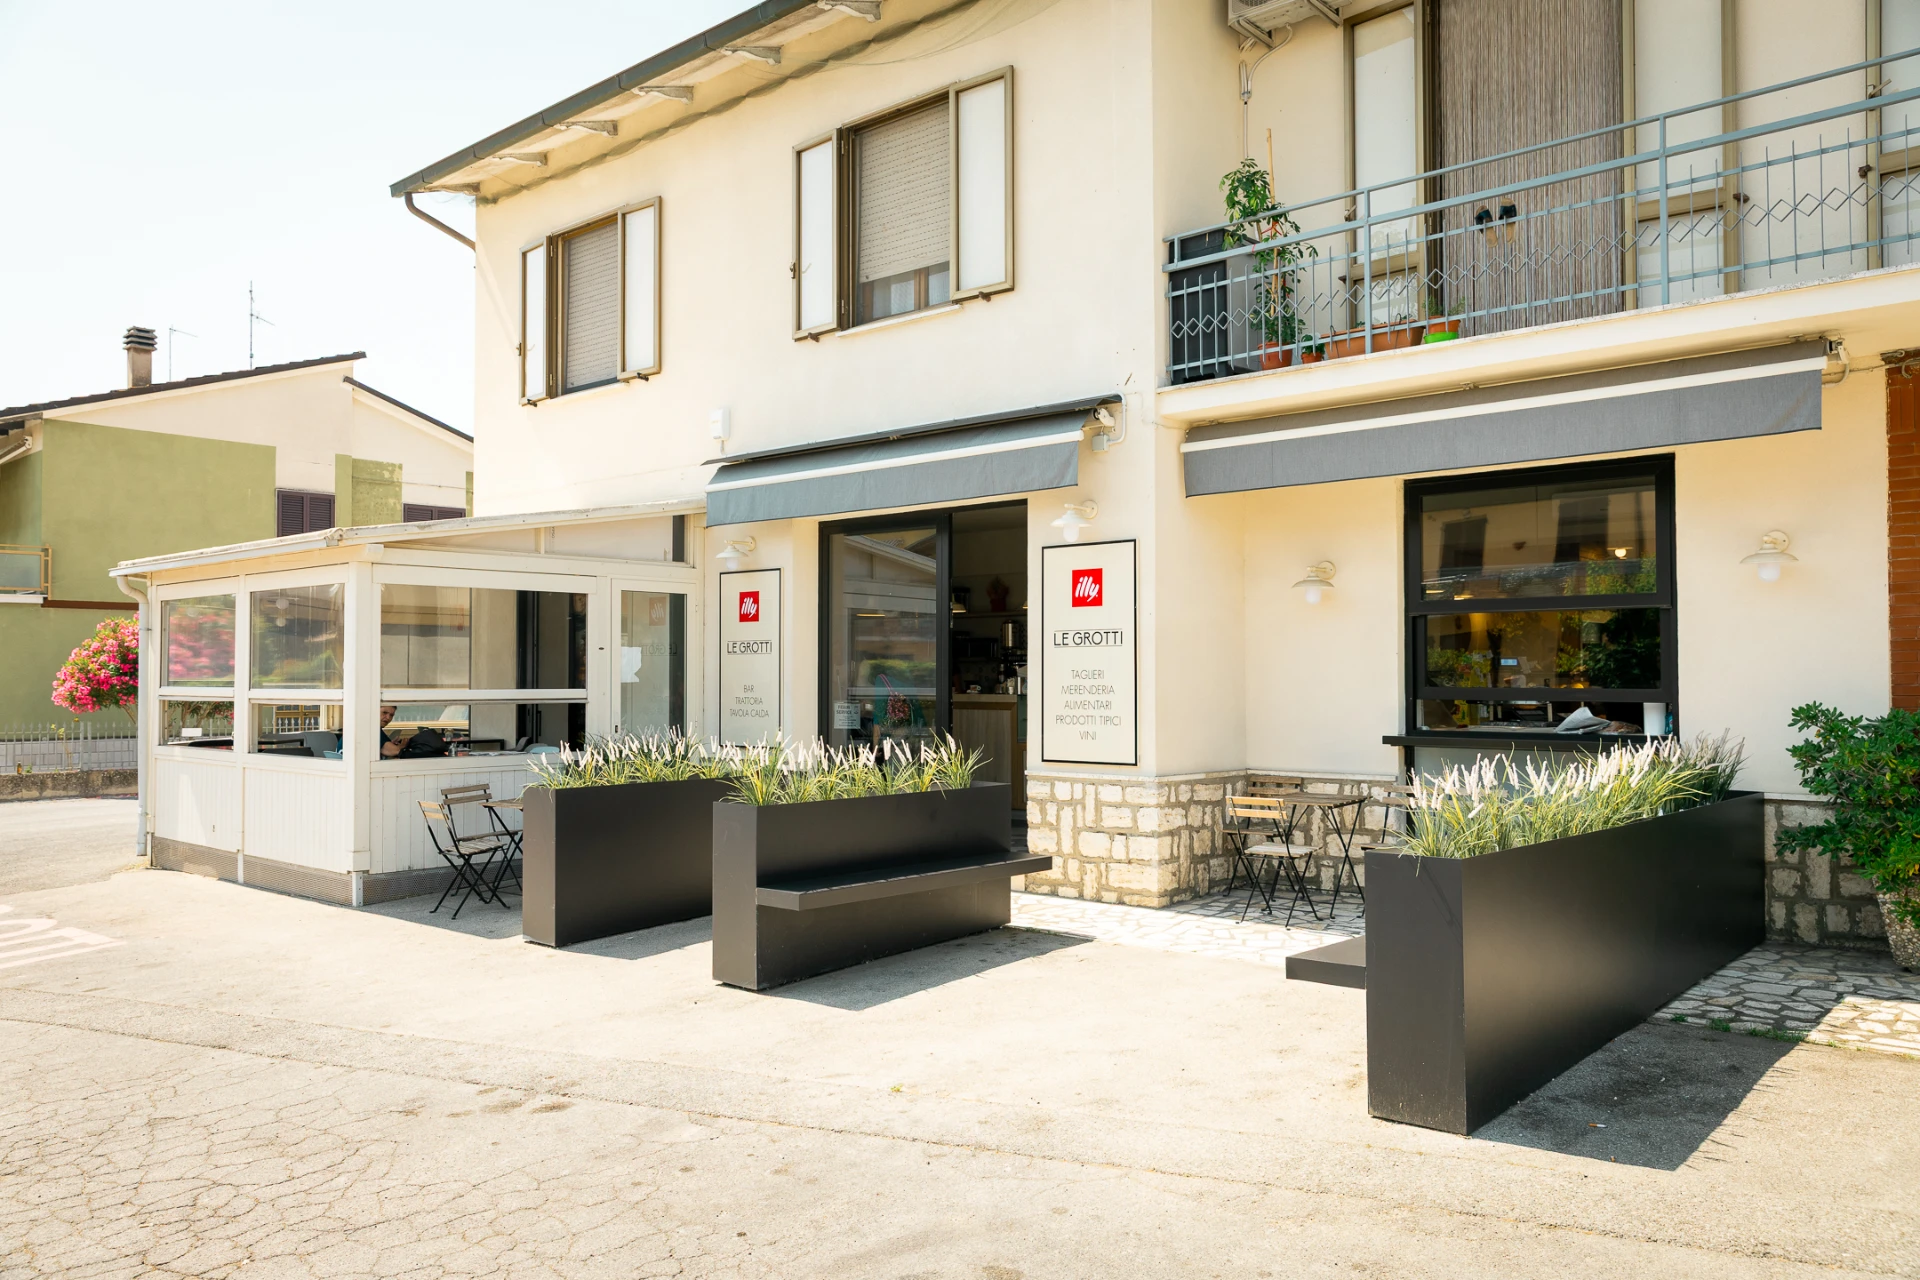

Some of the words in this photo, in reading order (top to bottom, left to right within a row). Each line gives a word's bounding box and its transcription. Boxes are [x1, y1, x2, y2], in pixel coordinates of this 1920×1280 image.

[1075, 576, 1100, 602] illy
[741, 597, 757, 619] illy
[1053, 633, 1069, 646] LE
[1072, 631, 1123, 646] GROTTI
[727, 643, 737, 654] LE
[739, 641, 772, 654] GROTTI
[1070, 669, 1105, 680] TAGLIERI
[743, 684, 755, 693] BAR
[1061, 684, 1116, 695] MERENDERIA
[735, 696, 763, 706] TRATTORIA
[1064, 699, 1112, 710] ALIMENTARI
[729, 708, 749, 718] TAVOLA
[750, 708, 770, 718] CALDA
[1055, 714, 1097, 725] PRODOTTI
[1099, 715, 1122, 726] TIPICI
[1078, 730, 1097, 741] VINI
